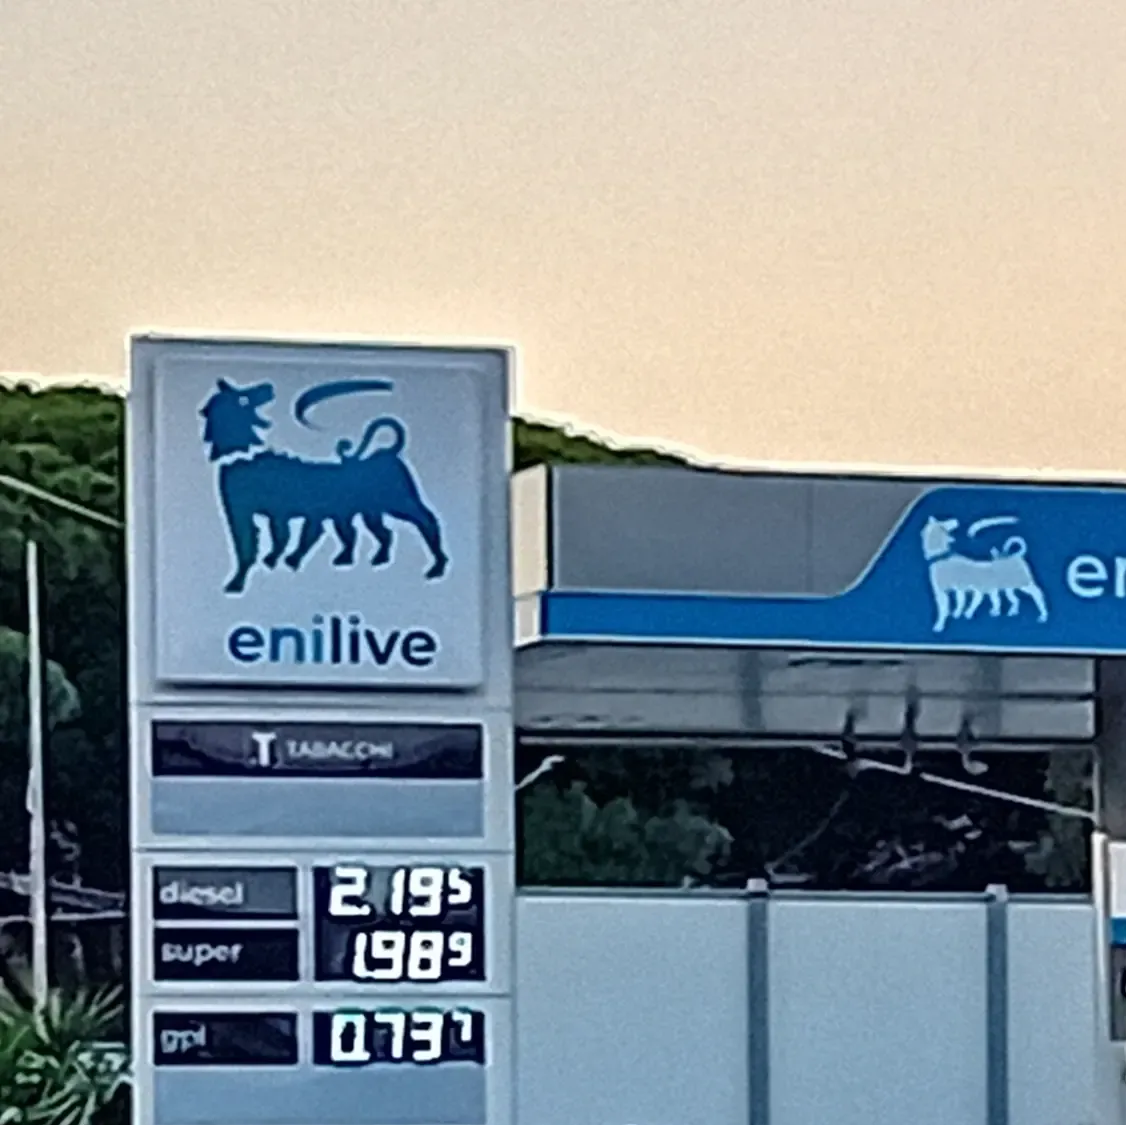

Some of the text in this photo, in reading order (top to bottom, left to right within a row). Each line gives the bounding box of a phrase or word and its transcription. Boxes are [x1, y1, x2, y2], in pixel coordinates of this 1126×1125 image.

[228, 614, 437, 666] enilive
[160, 880, 244, 905] diesel
[161, 942, 243, 966] super
[160, 1023, 206, 1053] gpl
